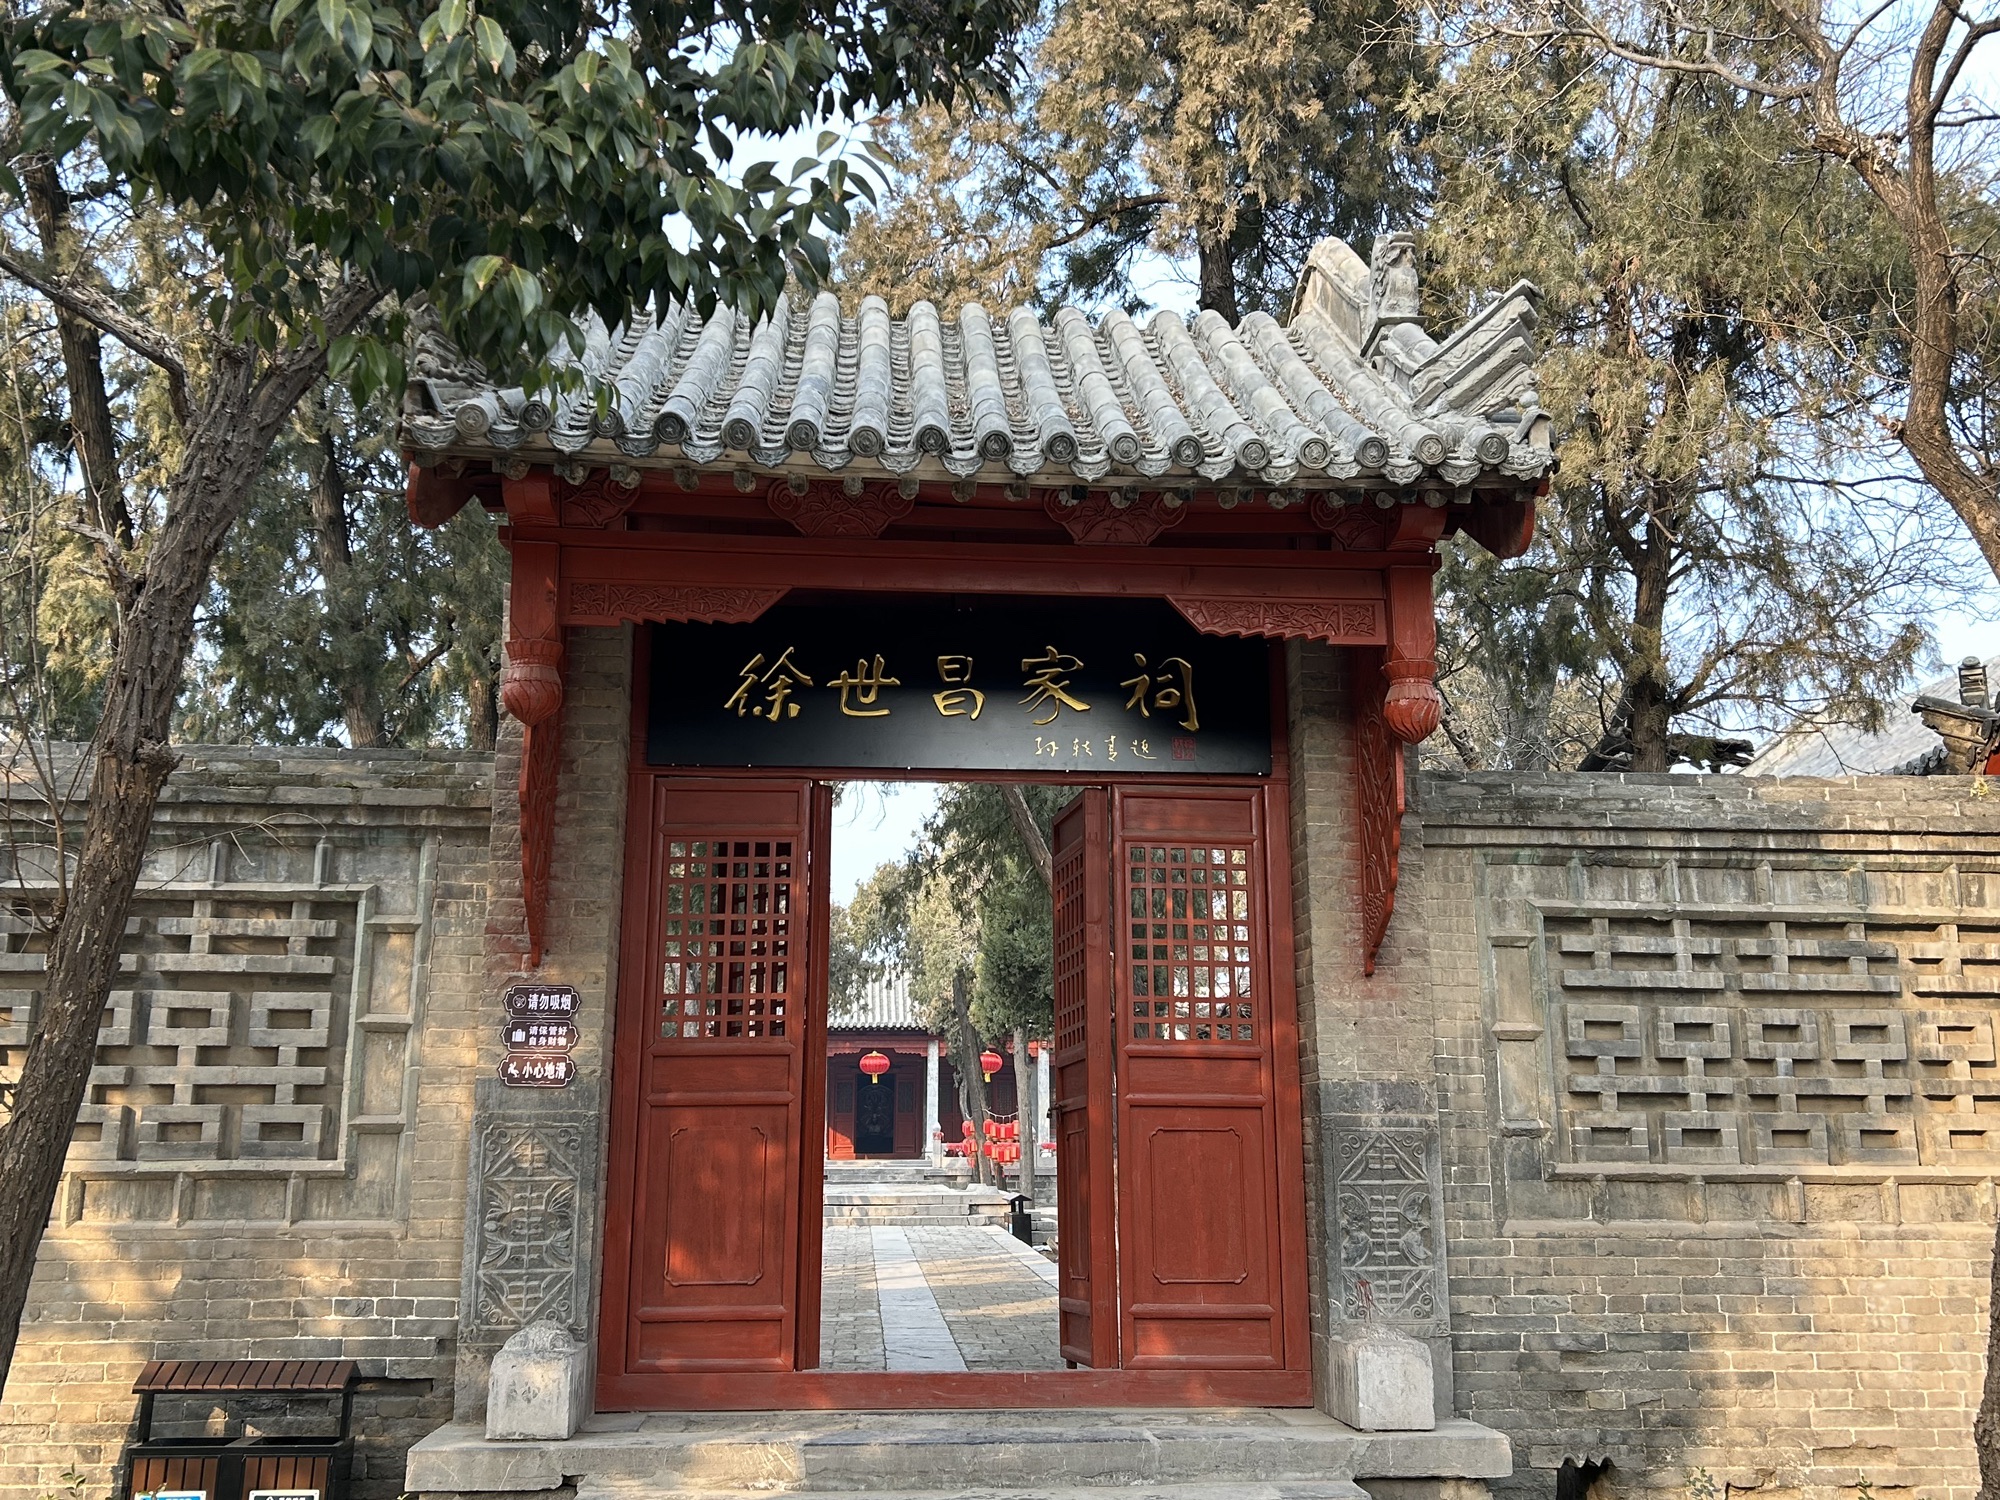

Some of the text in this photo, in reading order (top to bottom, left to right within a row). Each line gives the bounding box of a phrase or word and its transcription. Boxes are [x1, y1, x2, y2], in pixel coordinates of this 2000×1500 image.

[724, 646, 1199, 731] 徐世昌家祠
[528, 993, 572, 1010] 请勿吸烟
[528, 1026, 568, 1036] 请保管好
[528, 1036, 567, 1046] 自身财物
[522, 1061, 567, 1079] 小心地滑
